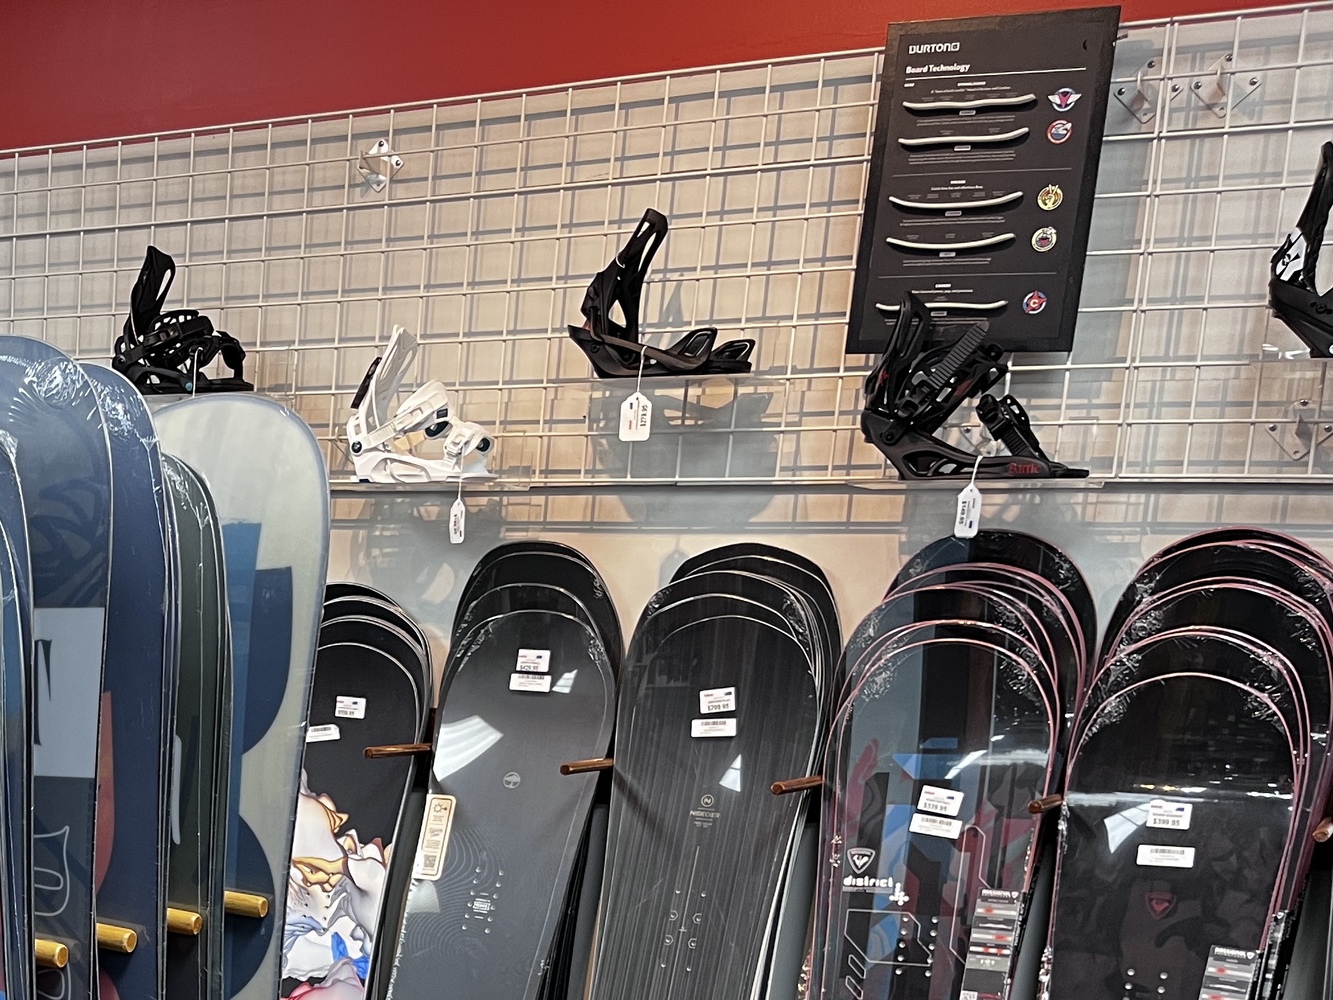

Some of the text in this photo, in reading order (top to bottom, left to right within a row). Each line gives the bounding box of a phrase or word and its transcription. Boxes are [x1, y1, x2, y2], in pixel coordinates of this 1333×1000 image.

[908, 42, 951, 54] BURTON
[905, 62, 971, 74] Board Technology
[843, 875, 894, 888] district
